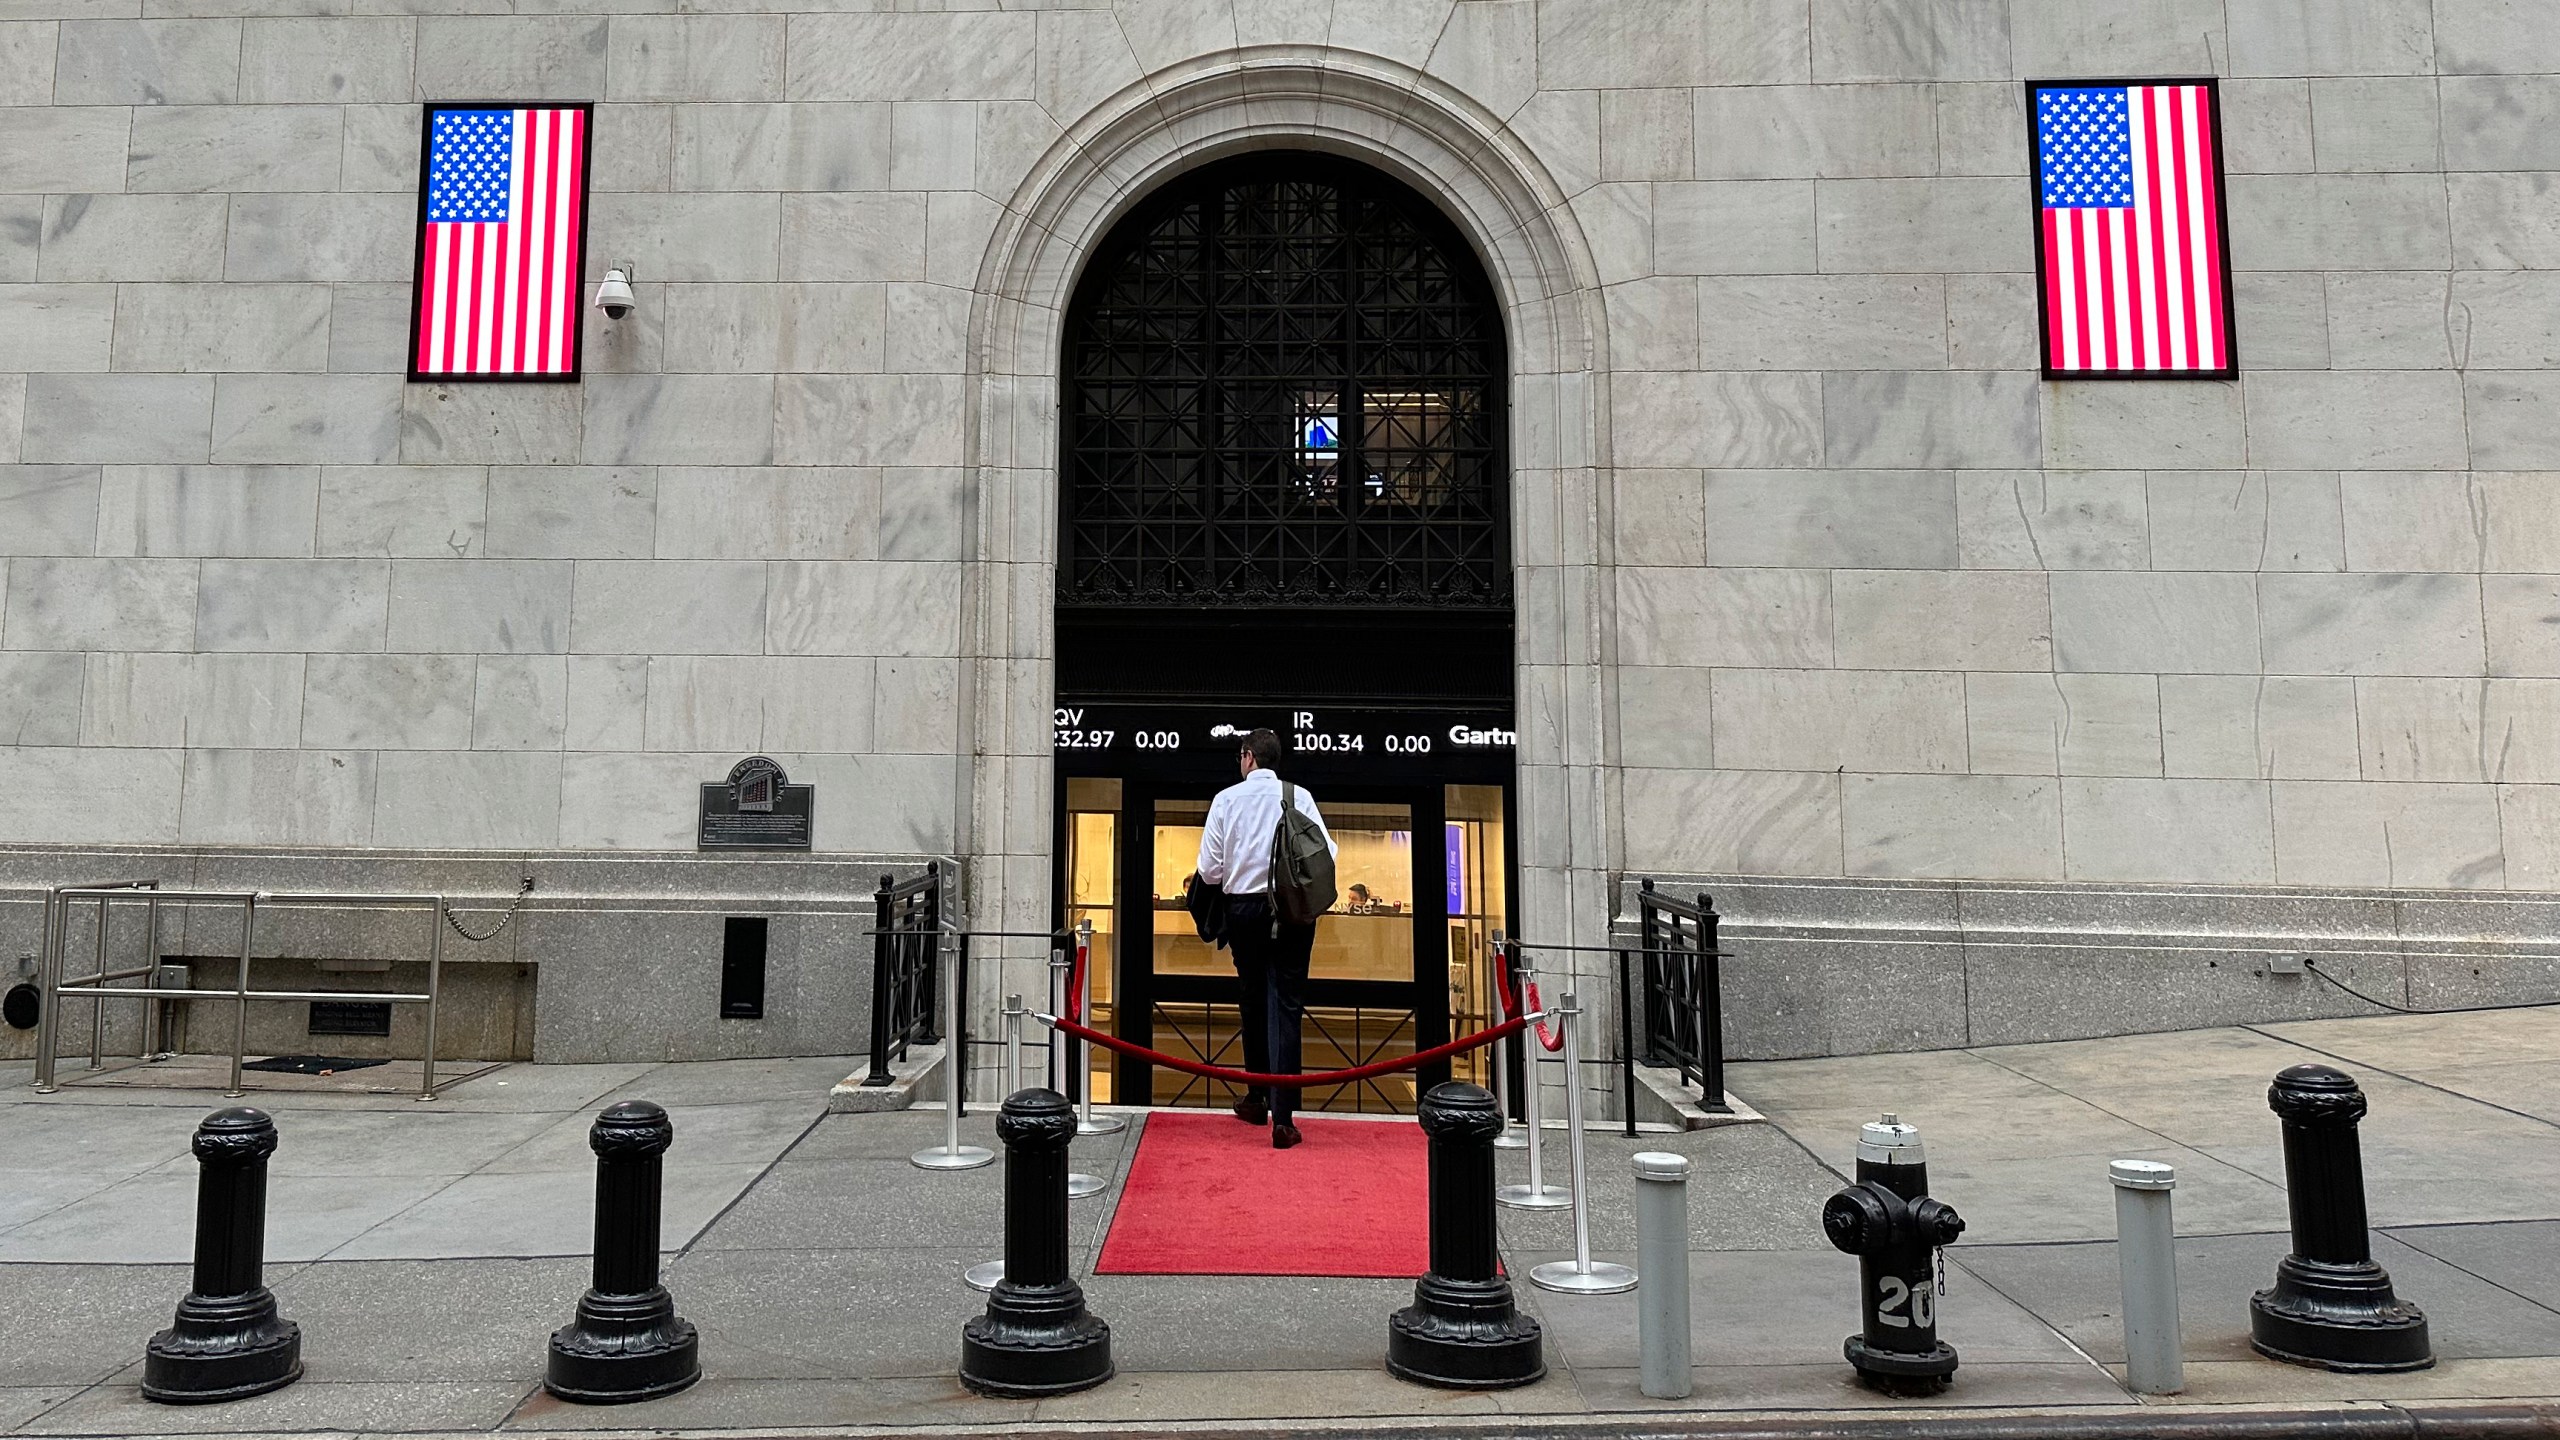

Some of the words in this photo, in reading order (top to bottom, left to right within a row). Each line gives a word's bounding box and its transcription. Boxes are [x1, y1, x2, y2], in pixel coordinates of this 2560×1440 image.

[1294, 711, 1314, 729] IR
[1135, 731, 1180, 749] 0.00
[1293, 733, 1364, 752] 100.34
[1385, 735, 1431, 753] 0.00
[1448, 725, 1516, 745] Gartn
[734, 760, 778, 778] FREEDOM
[776, 778, 785, 803] RING
[1878, 1275, 1935, 1329] 20
